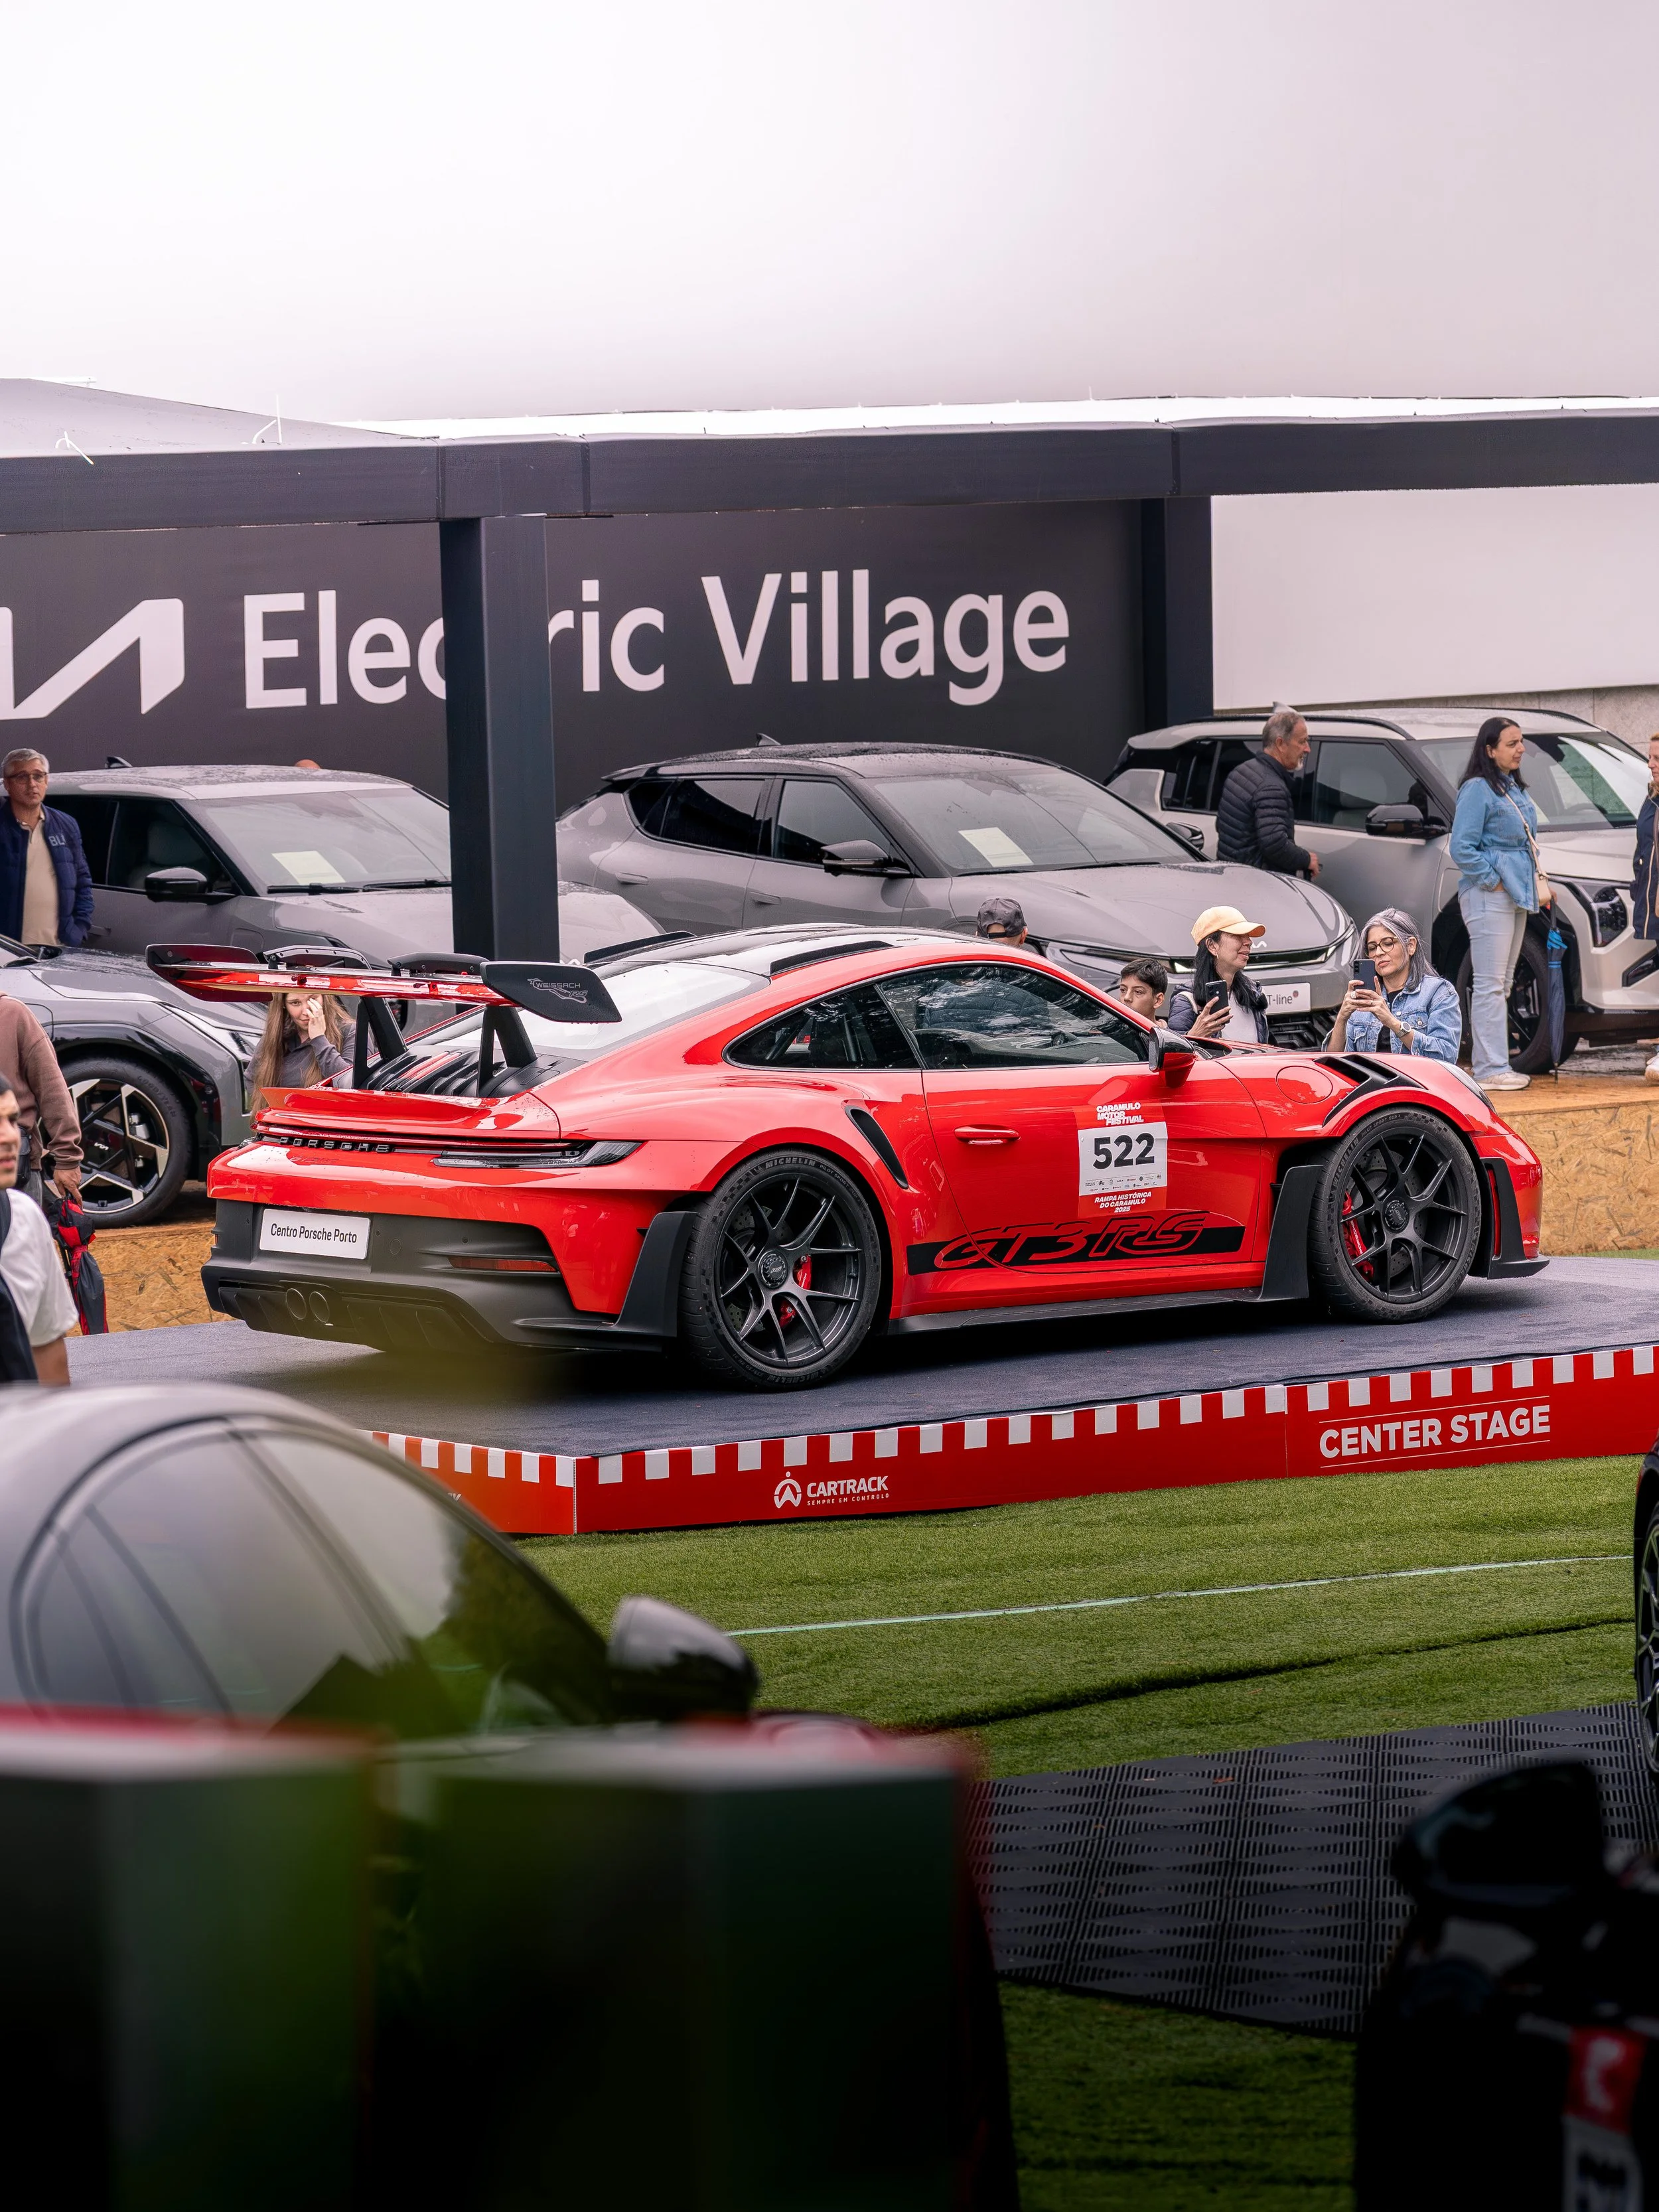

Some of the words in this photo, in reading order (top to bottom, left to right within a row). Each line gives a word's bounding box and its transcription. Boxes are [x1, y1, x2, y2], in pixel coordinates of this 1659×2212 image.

[244, 579, 666, 709] Elecric
[701, 568, 1070, 707] Village
[1266, 994, 1293, 1005] T-line
[1096, 1102, 1141, 1113] CARAMULO
[1096, 1110, 1126, 1121] MOTOR
[1105, 1115, 1145, 1126] FESTIVAL
[279, 1137, 390, 1153] PORSCHE
[1092, 1132, 1155, 1170] 522
[1332, 1136, 1360, 1189] MICHELIN
[764, 1157, 816, 1169] MICHELIN
[819, 1164, 834, 1175] PILOT
[834, 1173, 849, 1188] SPORT
[1110, 1198, 1147, 1207] CARAMULO
[1118, 1191, 1152, 1200] HISTÓRICA
[270, 1222, 298, 1238] Centro
[299, 1225, 332, 1241] Porsche
[333, 1228, 358, 1243] Porto
[1319, 1418, 1442, 1459] CENTER
[1450, 1404, 1550, 1443] STAGE
[806, 1475, 889, 1498] CARTRACK
[851, 1493, 890, 1502] CONTROLO
